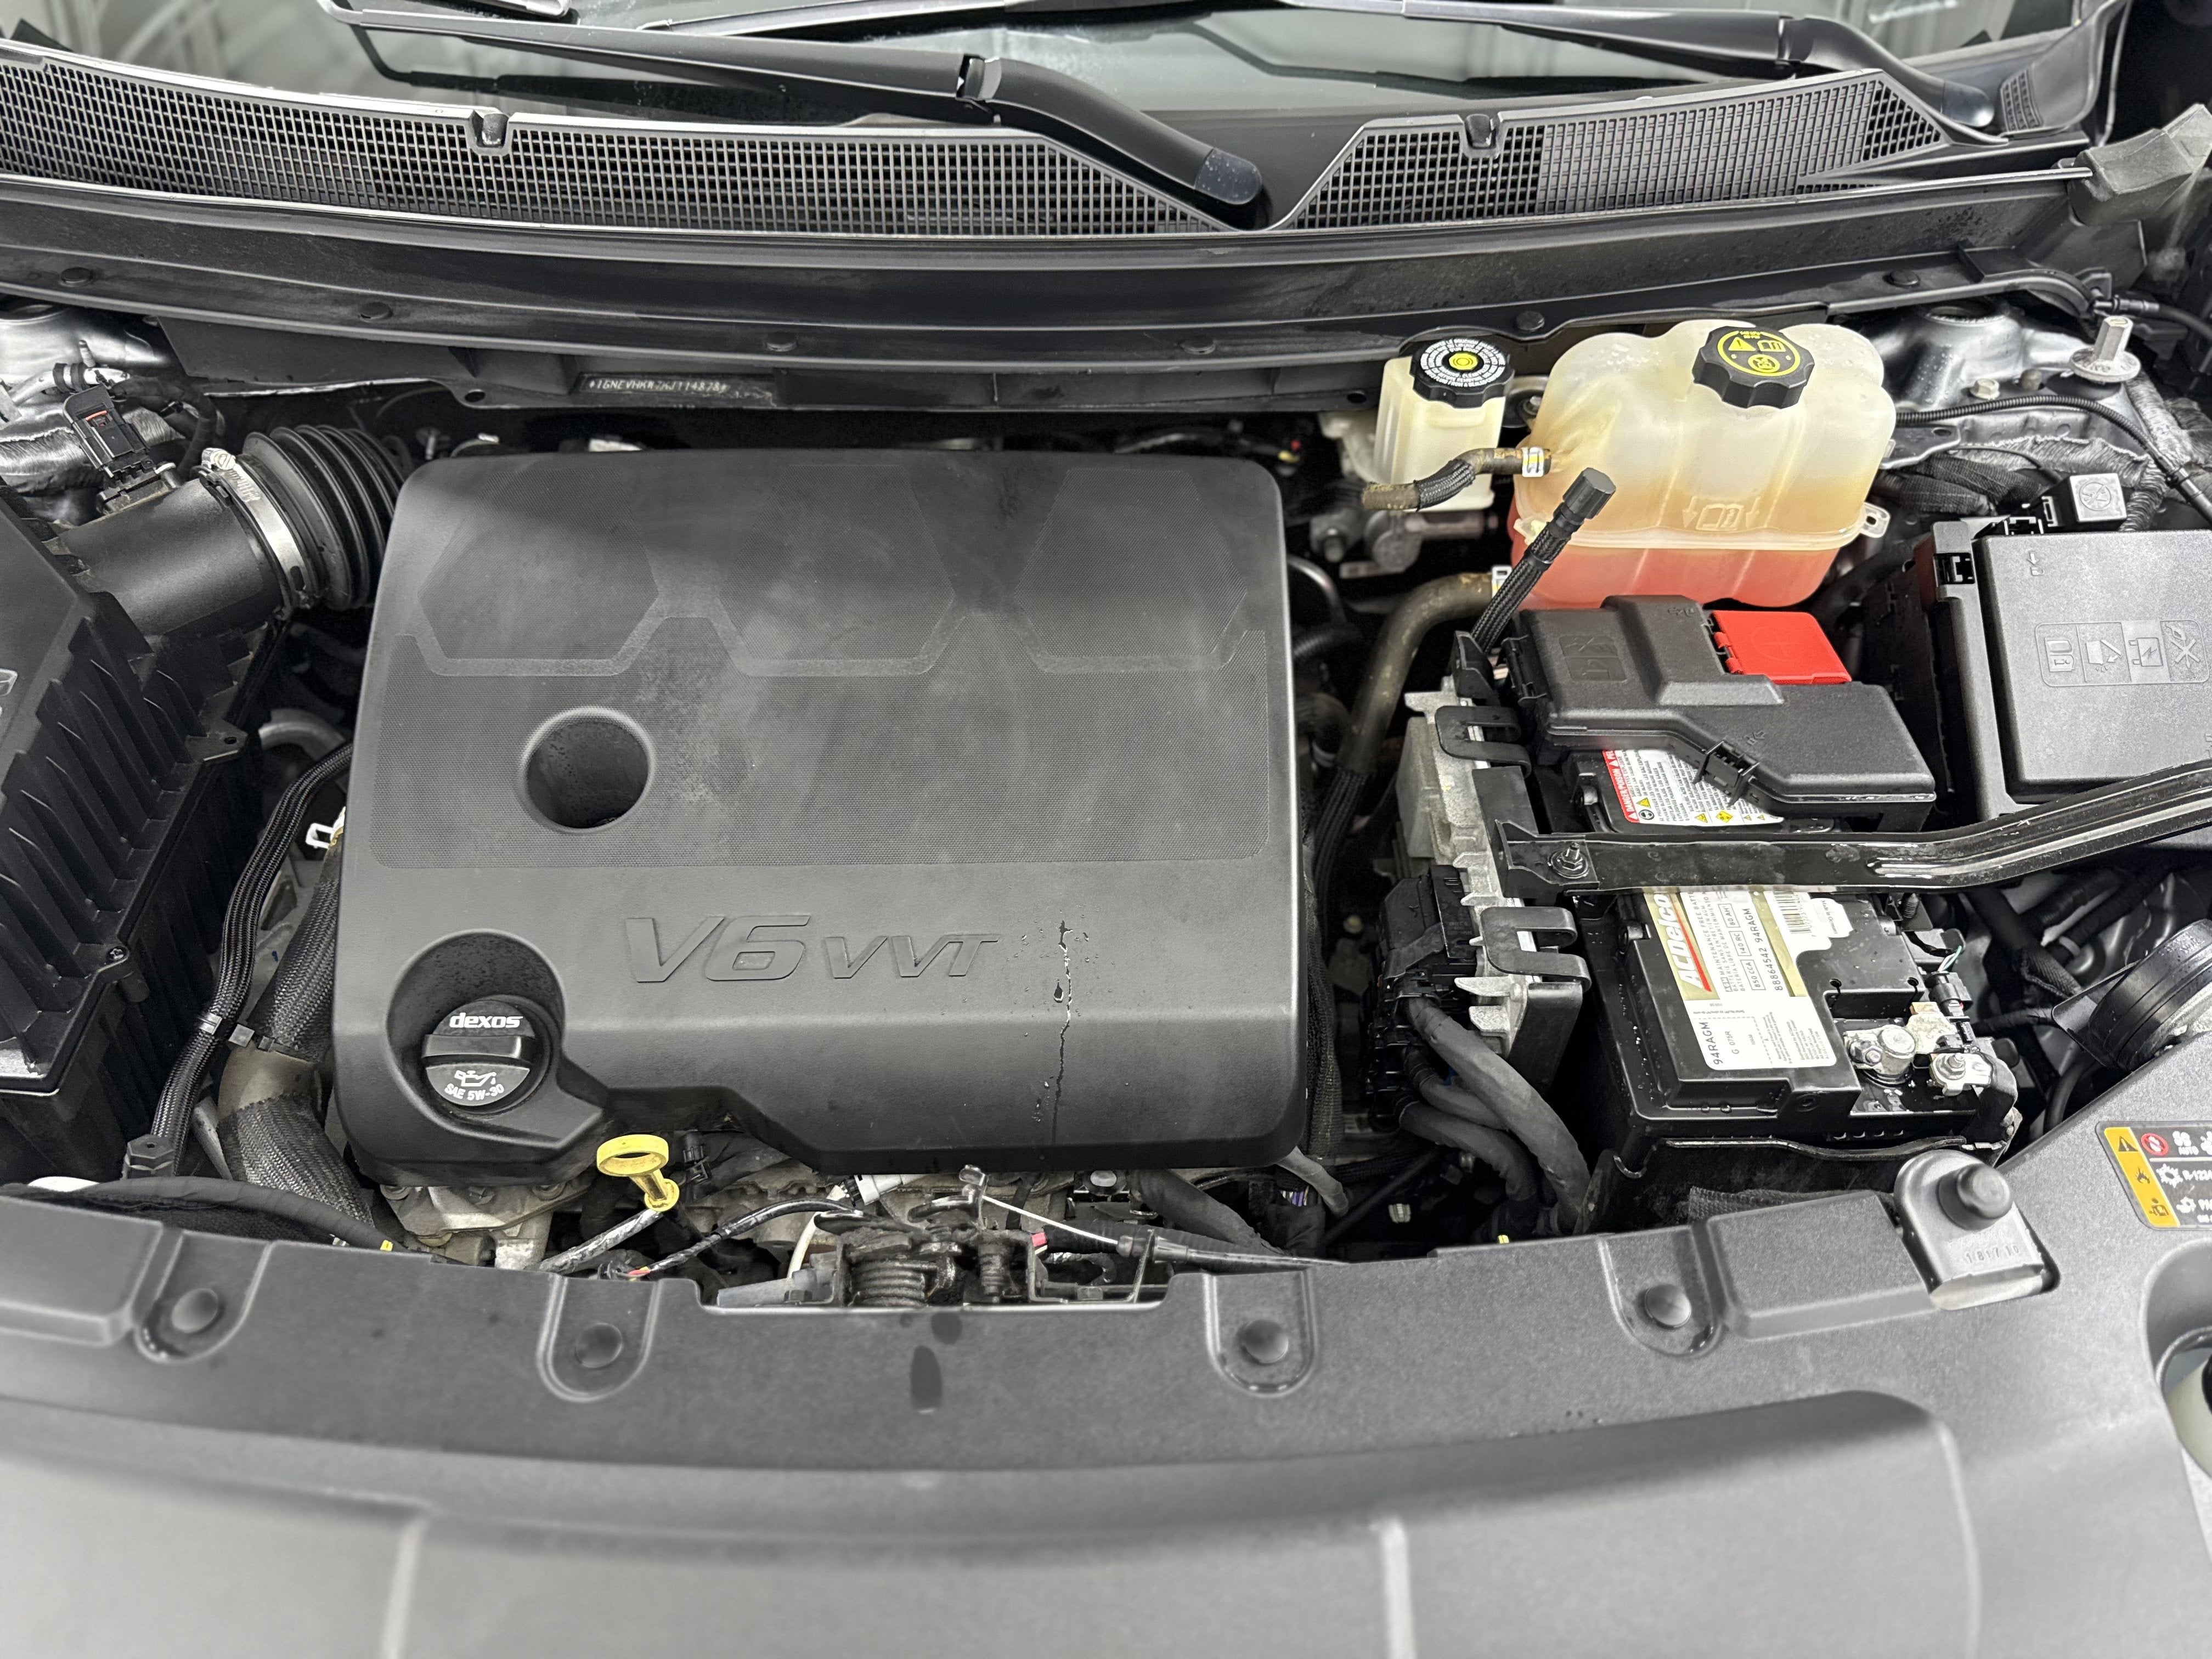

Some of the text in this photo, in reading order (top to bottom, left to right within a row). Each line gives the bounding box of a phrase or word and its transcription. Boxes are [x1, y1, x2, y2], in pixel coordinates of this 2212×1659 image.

[1695, 912, 1706, 927] FREE
[1742, 909, 1763, 943] 94RAGM
[624, 915, 1001, 983] V6 VVT
[1652, 893, 1703, 989] ACDelco
[1703, 930, 1725, 975] MAINTENANCE
[1738, 943, 1746, 953] 140
[1746, 962, 1760, 988] 850 CCA
[1759, 948, 1782, 990] 88864542
[449, 1012, 523, 1028] dexos
[1700, 1022, 1723, 1064] 94RAGM
[1725, 1031, 1735, 1045] 075R
[444, 1084, 505, 1101] SAE 5W-30
